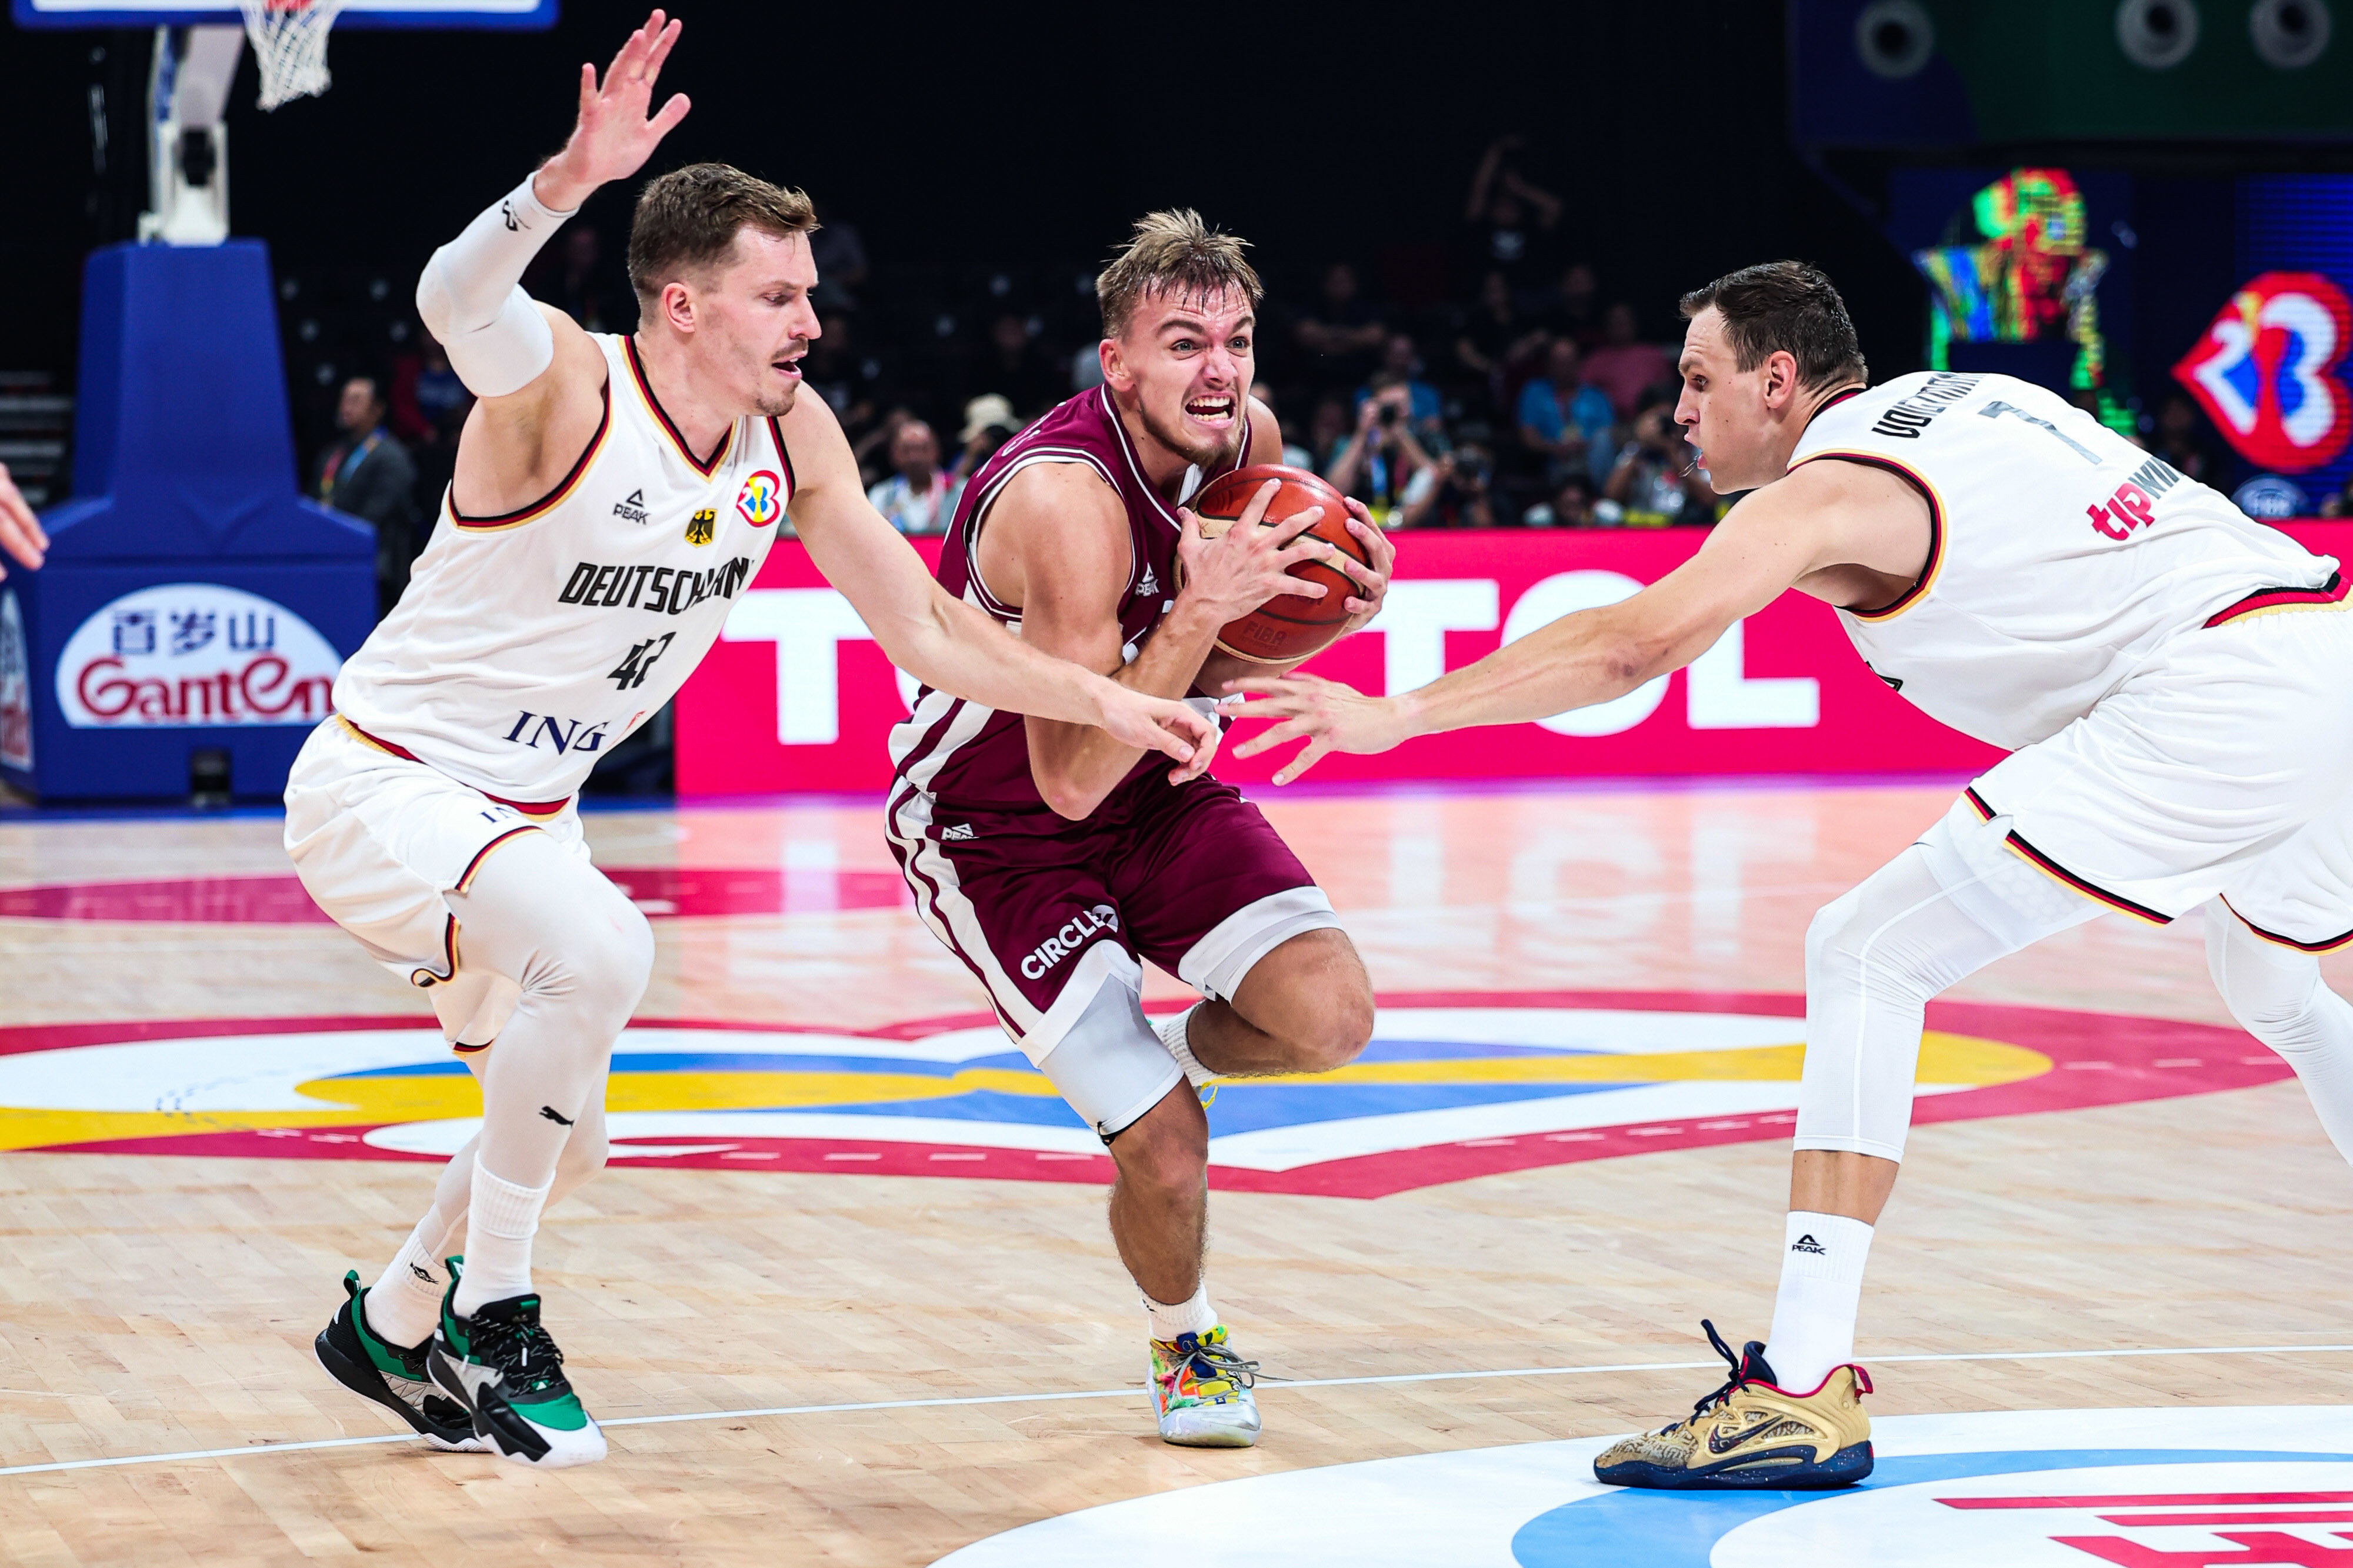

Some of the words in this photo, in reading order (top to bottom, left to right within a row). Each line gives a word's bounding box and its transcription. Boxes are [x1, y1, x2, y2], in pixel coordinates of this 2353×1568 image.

[1977, 401, 2103, 466] 7
[612, 503, 651, 525] PEAK
[557, 556, 755, 615] DEUTSCHLAN
[112, 608, 276, 655] 百岁山
[502, 710, 611, 756] ING
[1021, 910, 1106, 980] CIRCLE
[1792, 1244, 1827, 1256] PEAK
